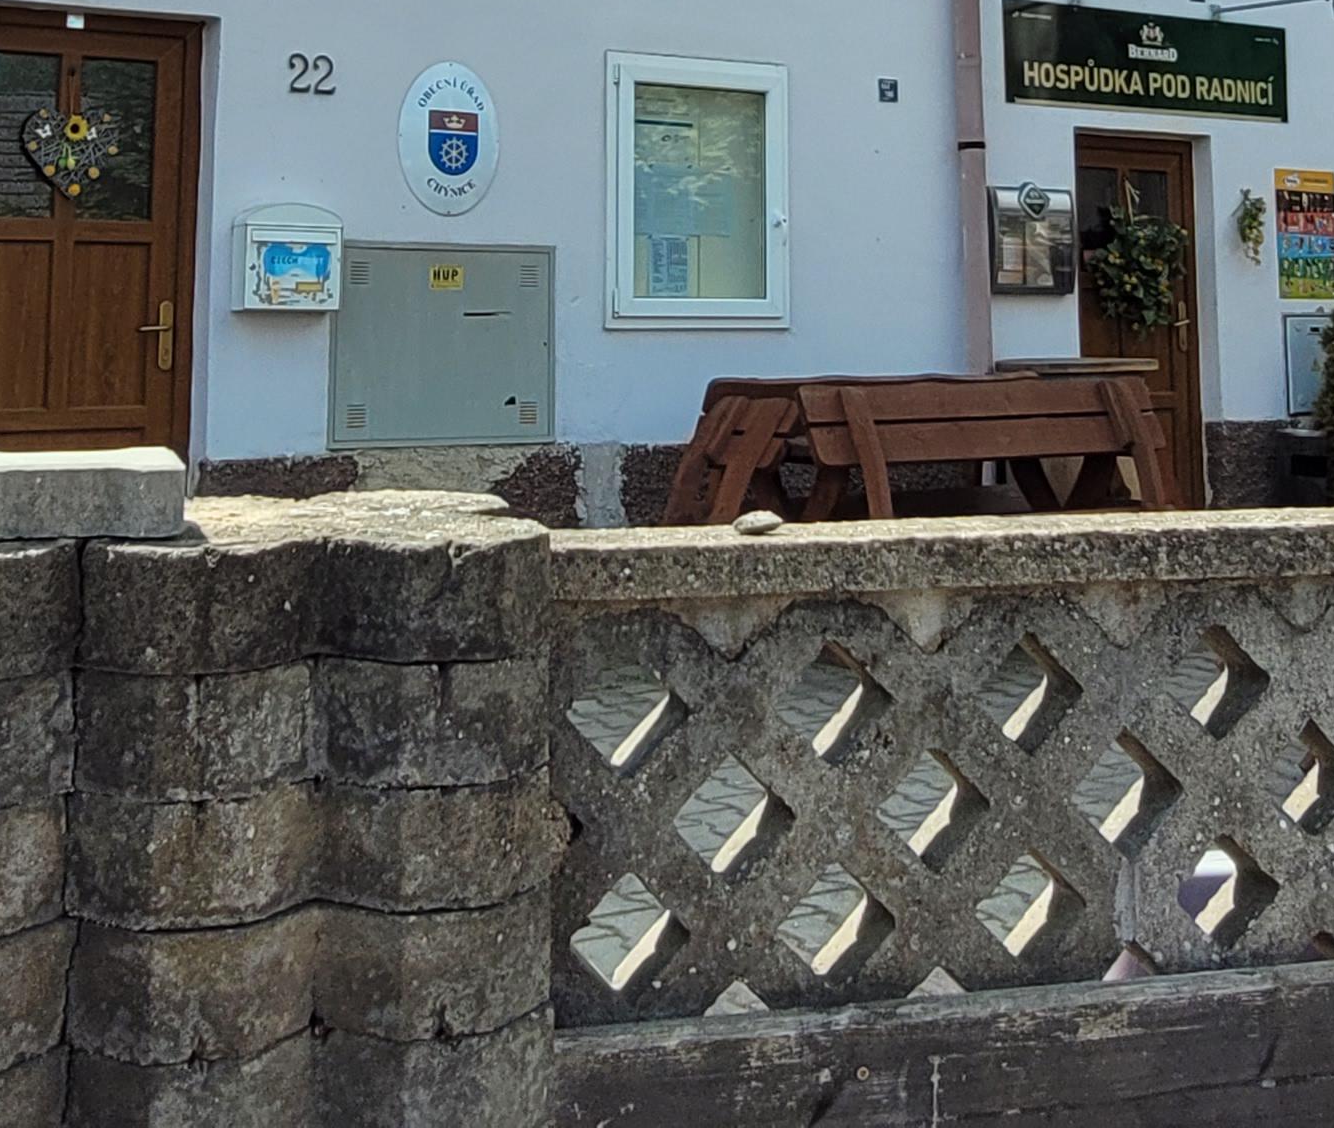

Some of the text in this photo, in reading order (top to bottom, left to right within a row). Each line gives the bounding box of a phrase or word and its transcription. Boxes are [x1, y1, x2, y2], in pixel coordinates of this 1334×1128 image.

[1127, 43, 1178, 62] BERNARD
[288, 52, 337, 96] 22
[1023, 59, 1273, 105] HOSPŮDKA POD RADNICÍ
[417, 77, 485, 113] OBECNÍ ÚŘAD
[426, 177, 476, 198] CHÝNICE
[433, 268, 459, 281] HUP
